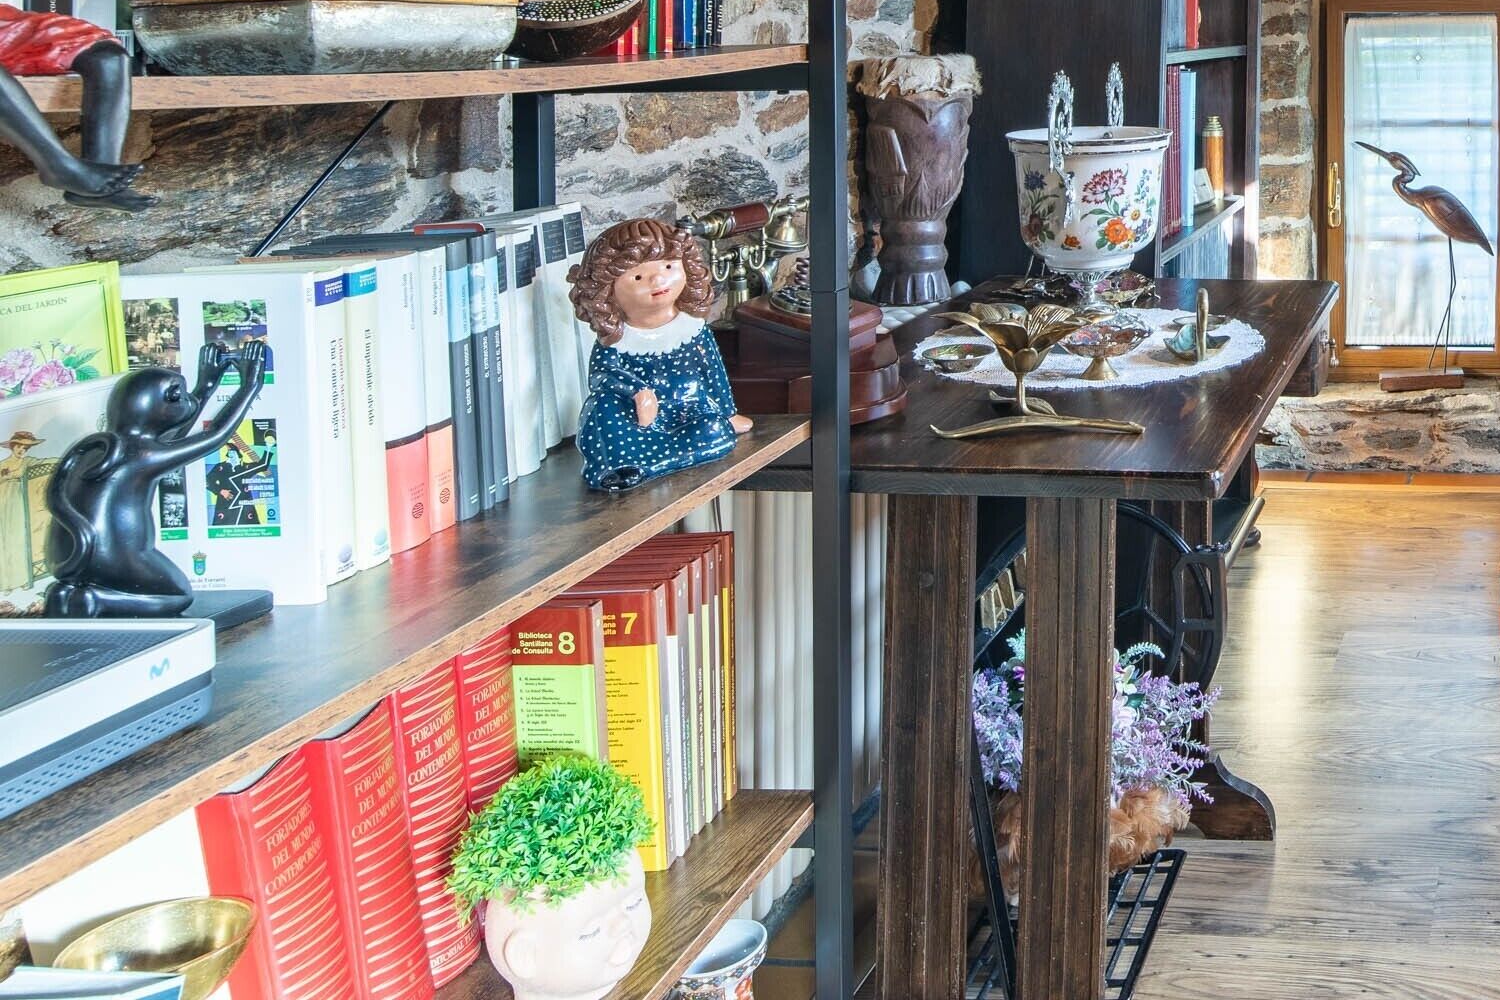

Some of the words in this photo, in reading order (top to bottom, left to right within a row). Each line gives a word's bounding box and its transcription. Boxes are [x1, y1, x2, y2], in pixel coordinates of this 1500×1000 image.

[15, 304, 33, 313] DEL
[36, 296, 68, 309] JARDÍN
[364, 328, 371, 340] El
[330, 339, 338, 361] Una
[363, 342, 374, 392] imposible
[331, 363, 340, 408] comedia
[331, 410, 341, 440] ligera
[366, 393, 376, 427] olvido
[620, 612, 638, 635] 7
[523, 647, 554, 655] Consulta
[558, 631, 576, 655] 8
[472, 671, 512, 706] FORJADO
[411, 706, 455, 748] FORJADORES
[475, 704, 492, 723] DEL
[415, 743, 433, 764] DEL
[433, 724, 456, 752] MUNDO
[359, 796, 376, 815] DEL
[266, 802, 312, 851] FORJADORES
[272, 847, 290, 869] DEL
[290, 820, 315, 851] MUNDO
